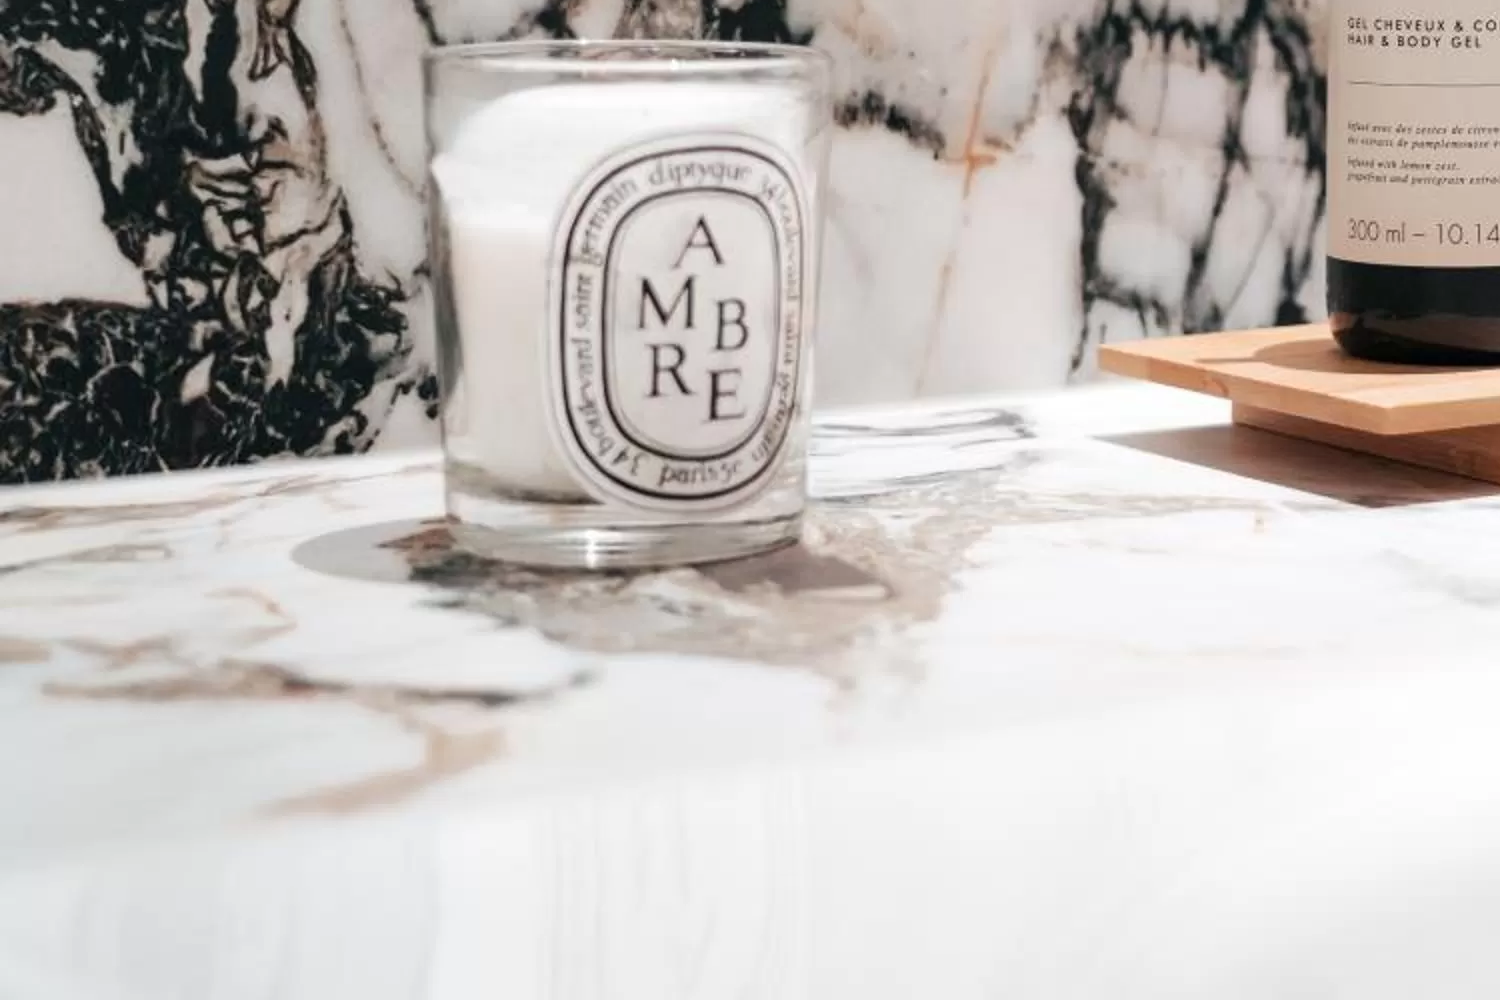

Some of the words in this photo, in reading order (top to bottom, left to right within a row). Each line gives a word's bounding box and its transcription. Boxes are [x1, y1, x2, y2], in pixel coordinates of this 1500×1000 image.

[1347, 17, 1368, 30] GEL
[1373, 19, 1446, 31] CHEVEUX
[1453, 20, 1464, 32] &
[1347, 33, 1374, 46] HAIR
[1380, 35, 1390, 47] &
[1397, 36, 1442, 48] BODY
[1451, 36, 1483, 48] GEL
[1451, 125, 1465, 134] de
[648, 158, 754, 188] diptyque
[1347, 218, 1380, 241] 300
[1385, 222, 1406, 242] ml
[1436, 223, 1500, 245] 10.14
[572, 273, 593, 331] saint
[570, 336, 615, 458] boulevard
[612, 448, 642, 477] 34
